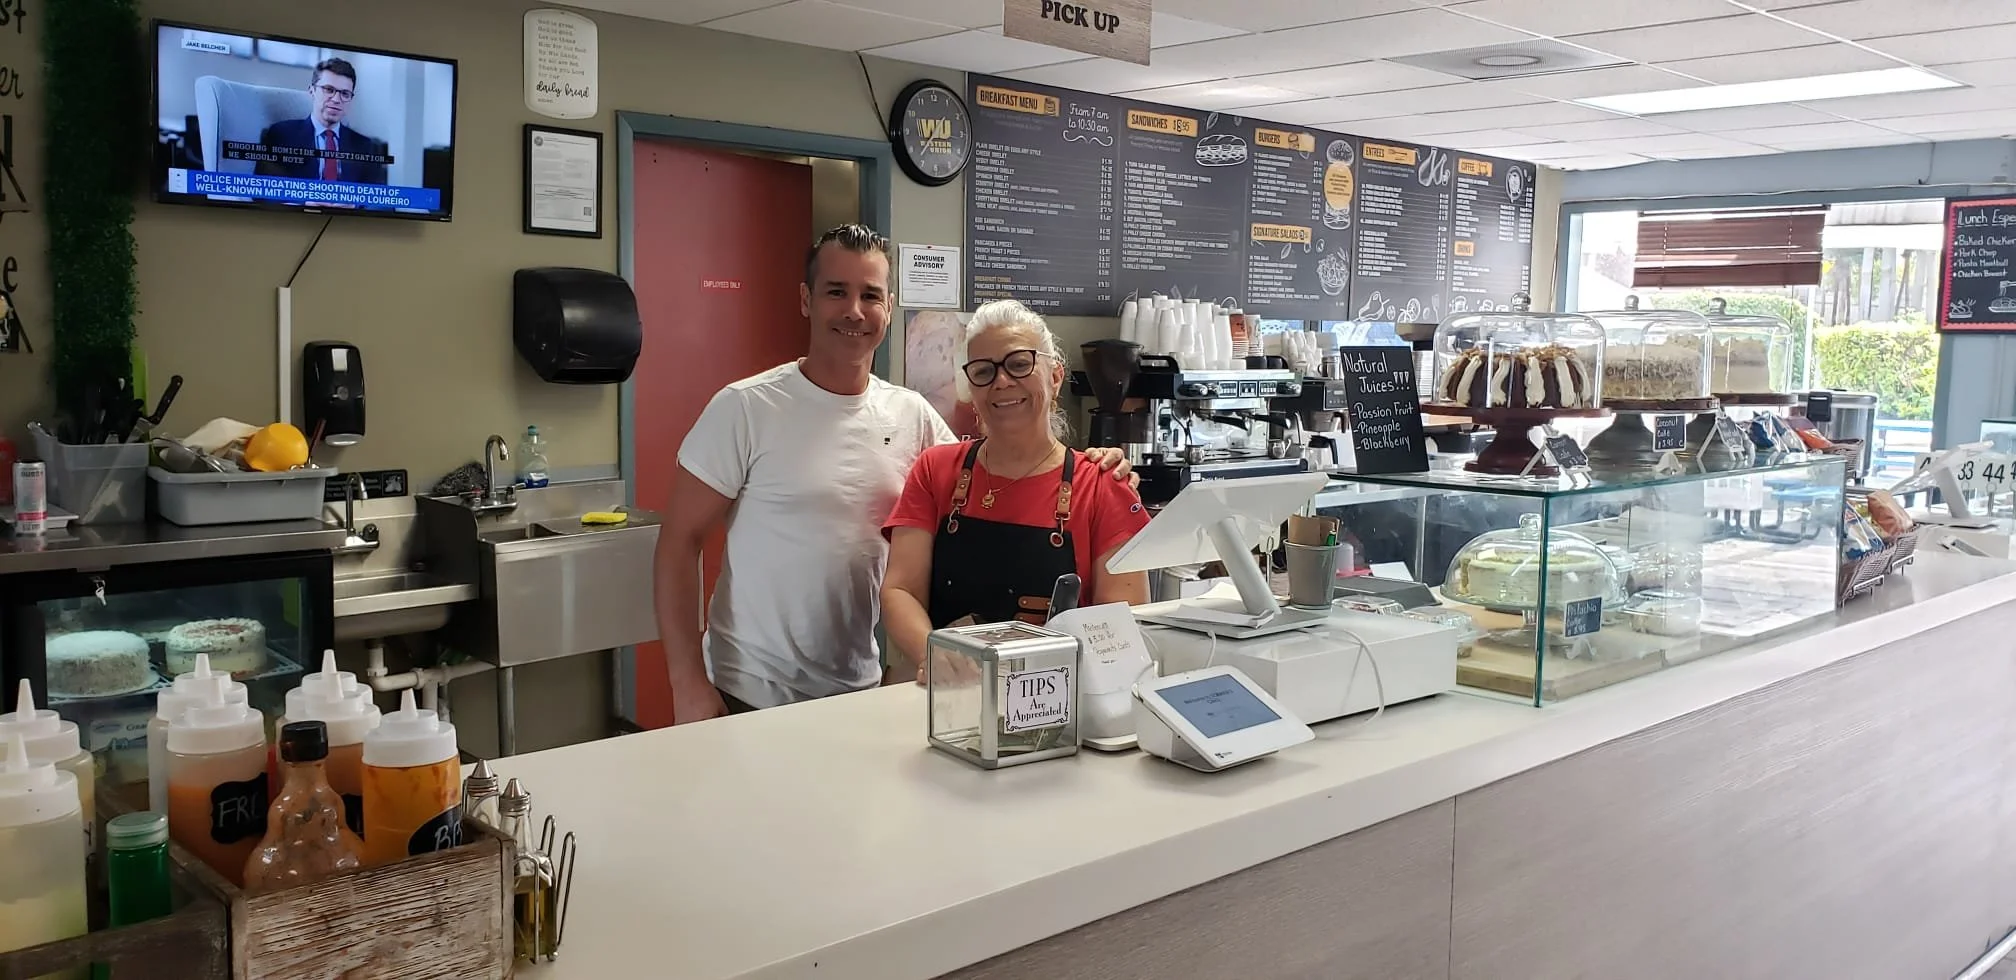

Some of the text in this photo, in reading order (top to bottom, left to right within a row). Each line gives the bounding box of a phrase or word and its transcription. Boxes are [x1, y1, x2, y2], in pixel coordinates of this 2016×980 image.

[1040, 0, 1120, 33] PICK UP
[536, 80, 590, 98] daily bread
[918, 98, 924, 106] 11
[930, 94, 938, 102] 12
[980, 90, 1038, 110] BREAKFAST MENU
[1070, 103, 1090, 117] From
[1090, 107, 1096, 116] 7
[1068, 118, 1076, 128] to
[1132, 114, 1168, 129] SANDWICHES
[905, 128, 910, 136] 9
[1258, 132, 1280, 144] BURGERS
[228, 142, 267, 152] ONGOING
[272, 146, 314, 156] HOMICIDE
[1366, 146, 1384, 158] ENTREES
[228, 152, 304, 164] WE SHOULD NOTE
[920, 160, 925, 168] 7
[934, 164, 938, 172] 6
[196, 173, 400, 196] POLICE INVESTIGATING SHOOTING DEATH OF
[196, 182, 410, 206] WELL-KNOWN MIT PROFESSOR NUNO LOUREIRO
[1958, 209, 1988, 224] Lunch
[1254, 226, 1280, 238] SIGNATURE
[1280, 228, 1298, 240] SALADS
[1958, 234, 1984, 246] Baked
[913, 254, 945, 262] CONSUMER
[1959, 248, 1997, 258] Pork Chop
[913, 261, 944, 269] ADVISORY
[1958, 259, 1978, 267] Pasta
[1958, 268, 2008, 278] Chicken Breast
[703, 280, 729, 289] EMPLOYEES
[1344, 352, 1388, 374] Natural
[1359, 371, 1410, 394] Juices!!!
[1393, 402, 1414, 416] Fruit
[1656, 416, 1678, 428] Coconut
[1958, 460, 1974, 480] 33
[1982, 462, 2005, 484] 44
[1020, 676, 1056, 698] TIPS
[1029, 698, 1046, 711] Are
[1013, 702, 1062, 722] Appreciated
